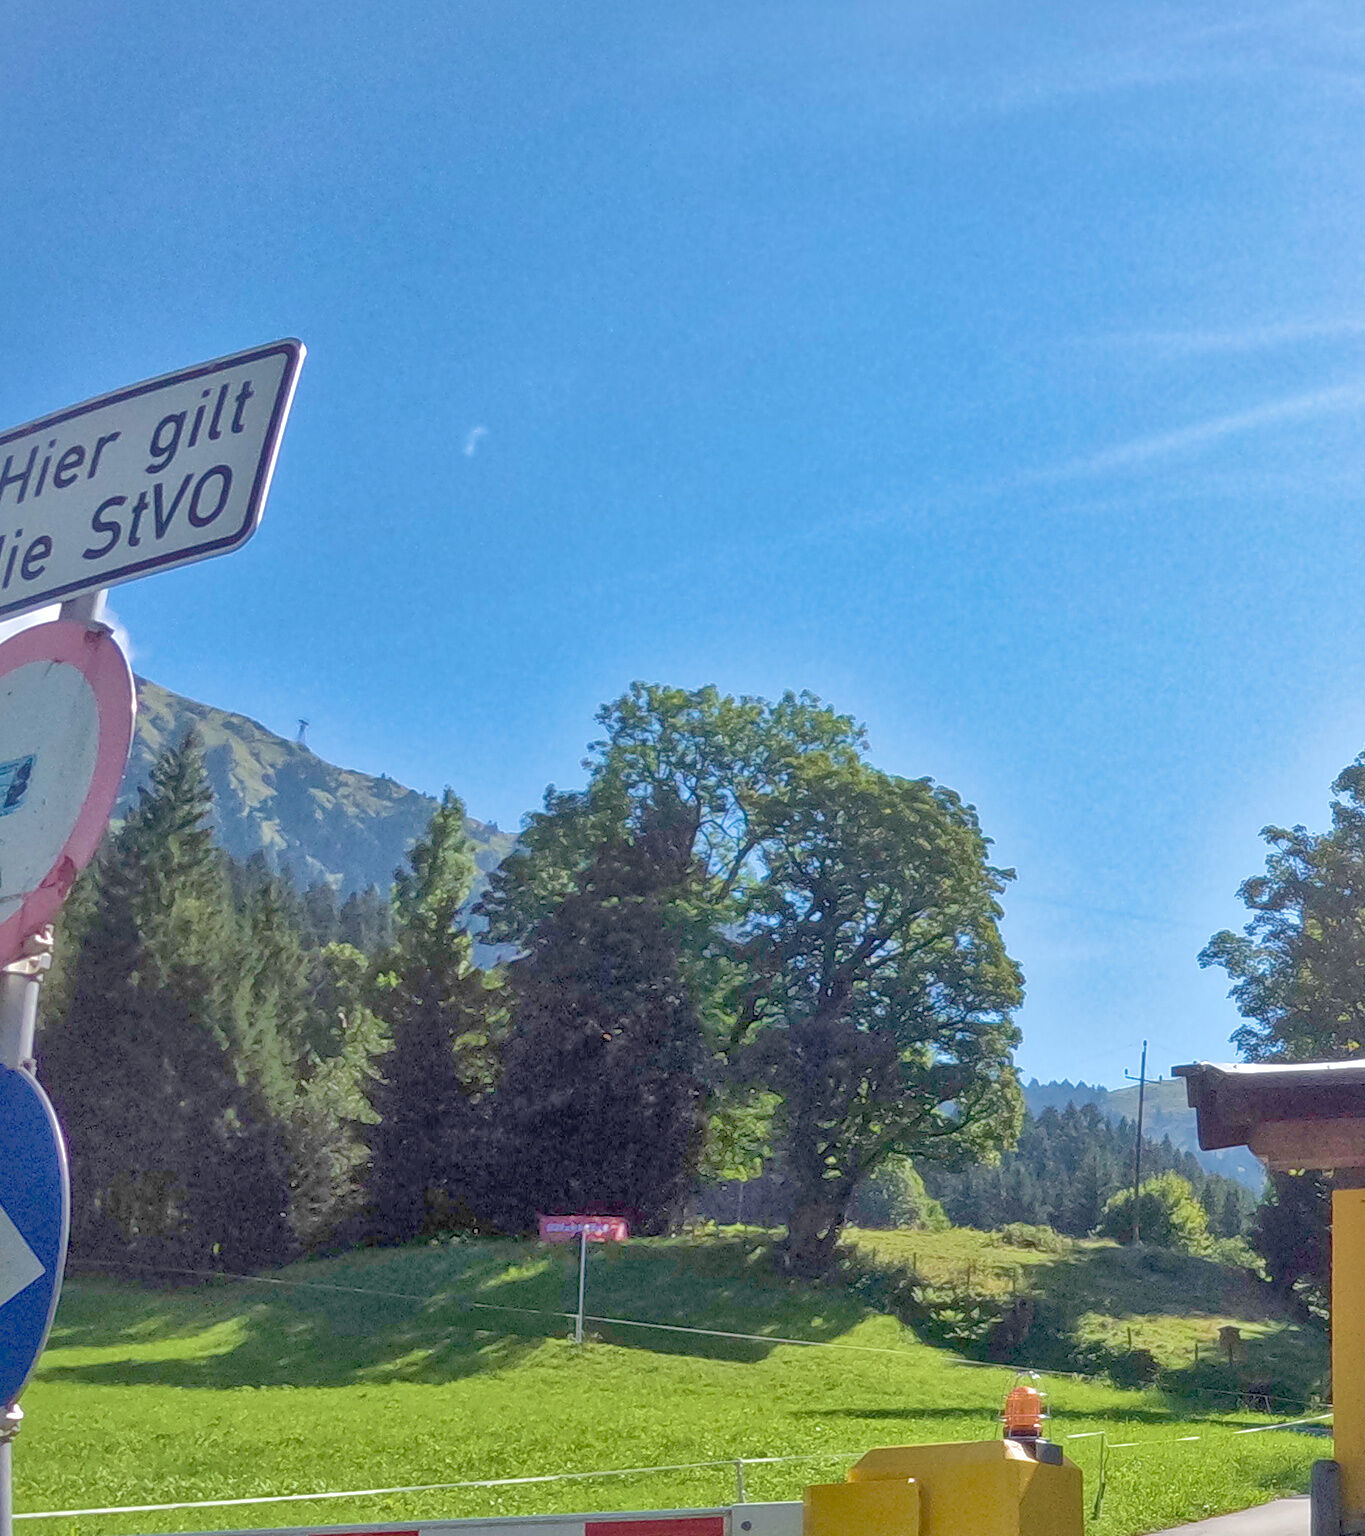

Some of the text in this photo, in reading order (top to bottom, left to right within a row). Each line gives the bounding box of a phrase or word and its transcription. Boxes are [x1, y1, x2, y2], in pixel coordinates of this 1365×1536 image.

[0, 380, 255, 504] Hier gilt
[0, 464, 233, 589] ie StVO
